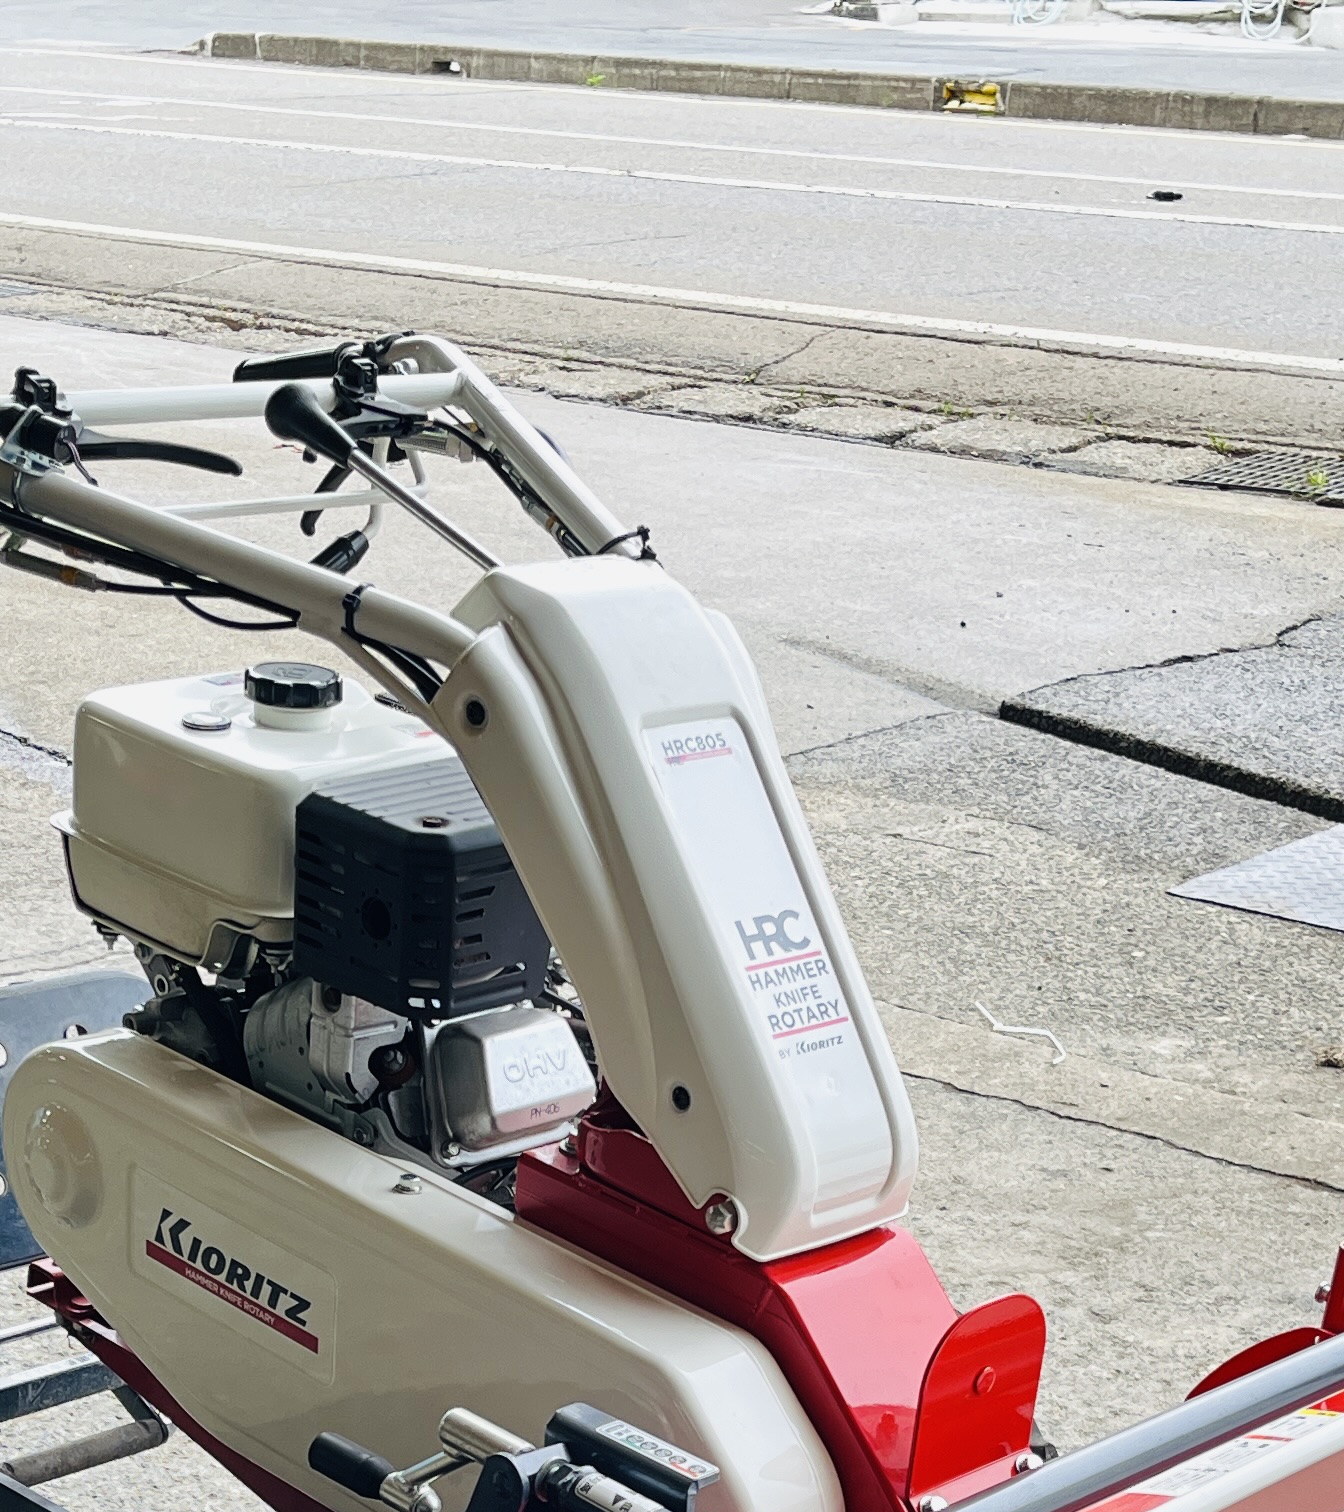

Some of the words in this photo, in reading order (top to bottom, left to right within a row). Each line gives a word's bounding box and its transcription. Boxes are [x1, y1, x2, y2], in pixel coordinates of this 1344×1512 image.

[661, 733, 726, 756] HRC805
[734, 909, 811, 961] HRC
[748, 959, 830, 992] HAMMER
[773, 984, 822, 1008] KNIFE
[767, 999, 840, 1033] ROTARY
[778, 1048, 792, 1060] BY
[796, 1035, 844, 1056] KIORITZ
[503, 1048, 567, 1084] OHV
[154, 1207, 312, 1328] KIORITZ
[185, 1267, 219, 1294] HAMMER
[219, 1287, 243, 1308] KNIFE
[243, 1300, 275, 1326] ROTARY
